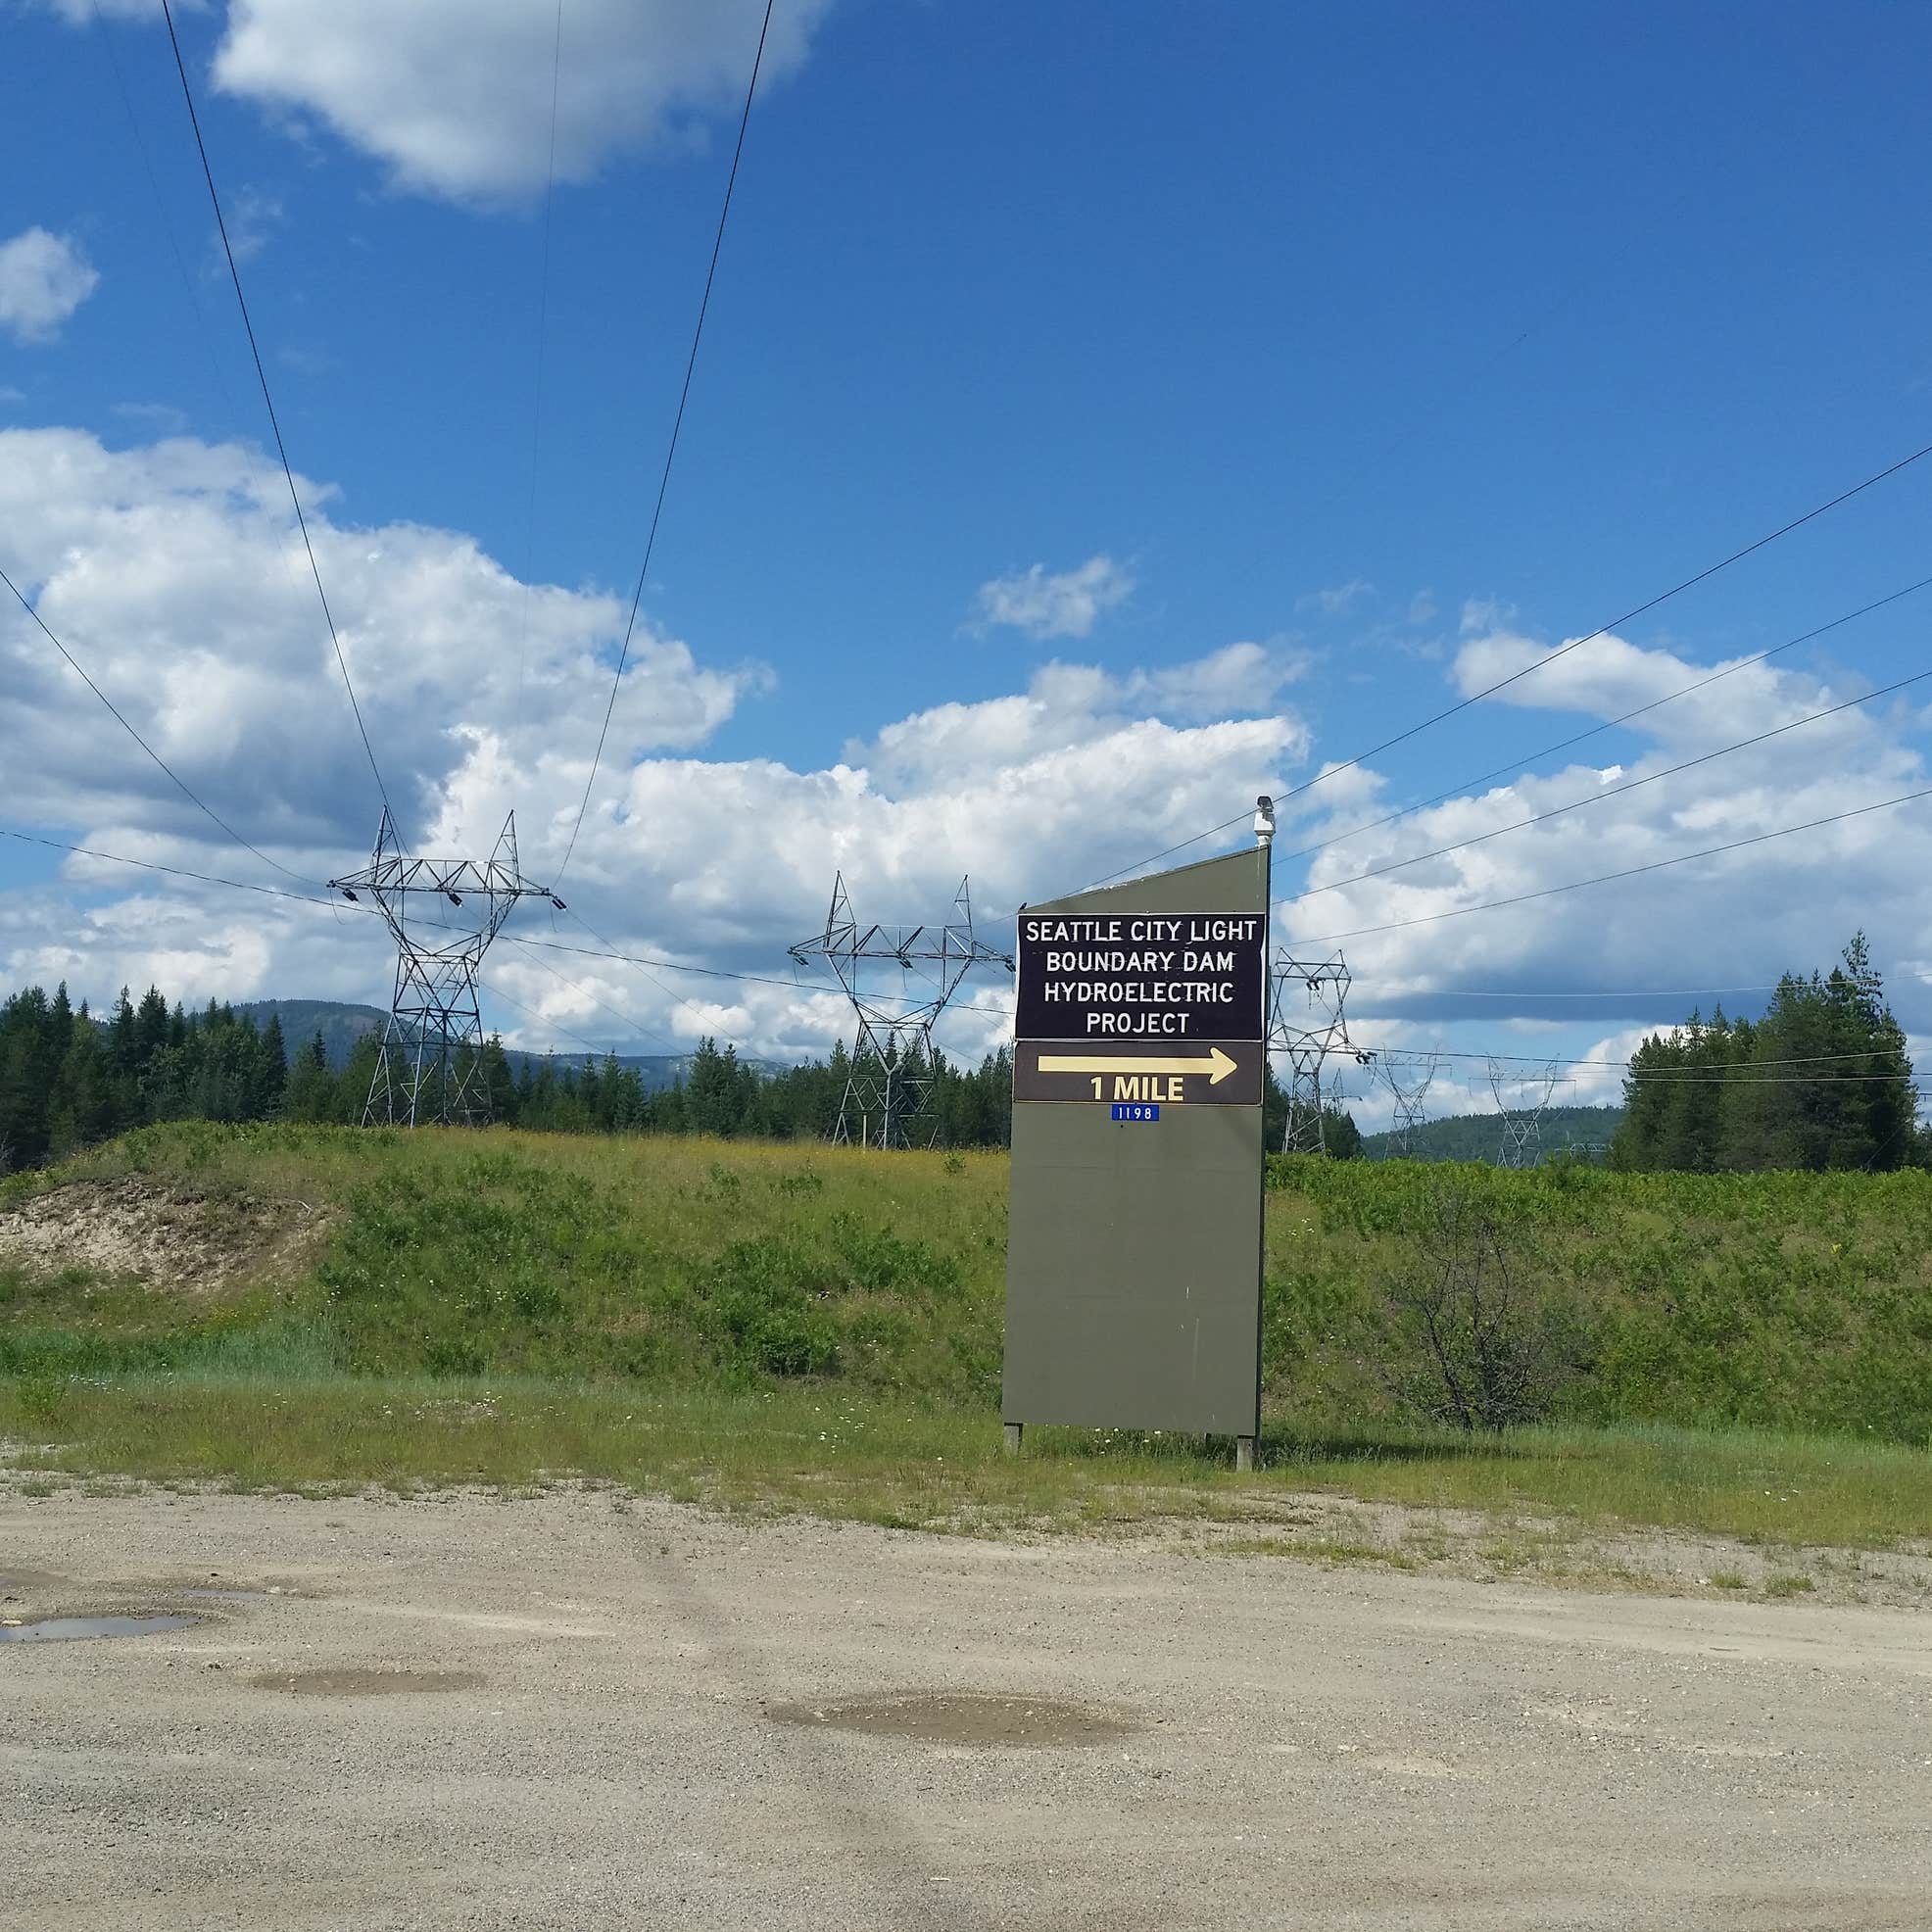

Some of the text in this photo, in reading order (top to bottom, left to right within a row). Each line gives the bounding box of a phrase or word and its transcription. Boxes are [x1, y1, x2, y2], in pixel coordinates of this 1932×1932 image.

[1026, 920, 1257, 942] SEATTLE CITY LIGHT
[1046, 951, 1236, 972] BOUNDARY DAM
[1044, 982, 1233, 1002] HYDROELECTRIC
[1087, 1012, 1190, 1034] PROJECT
[1091, 1076, 1183, 1101] 1 MILE
[1119, 1107, 1152, 1120] 1198
